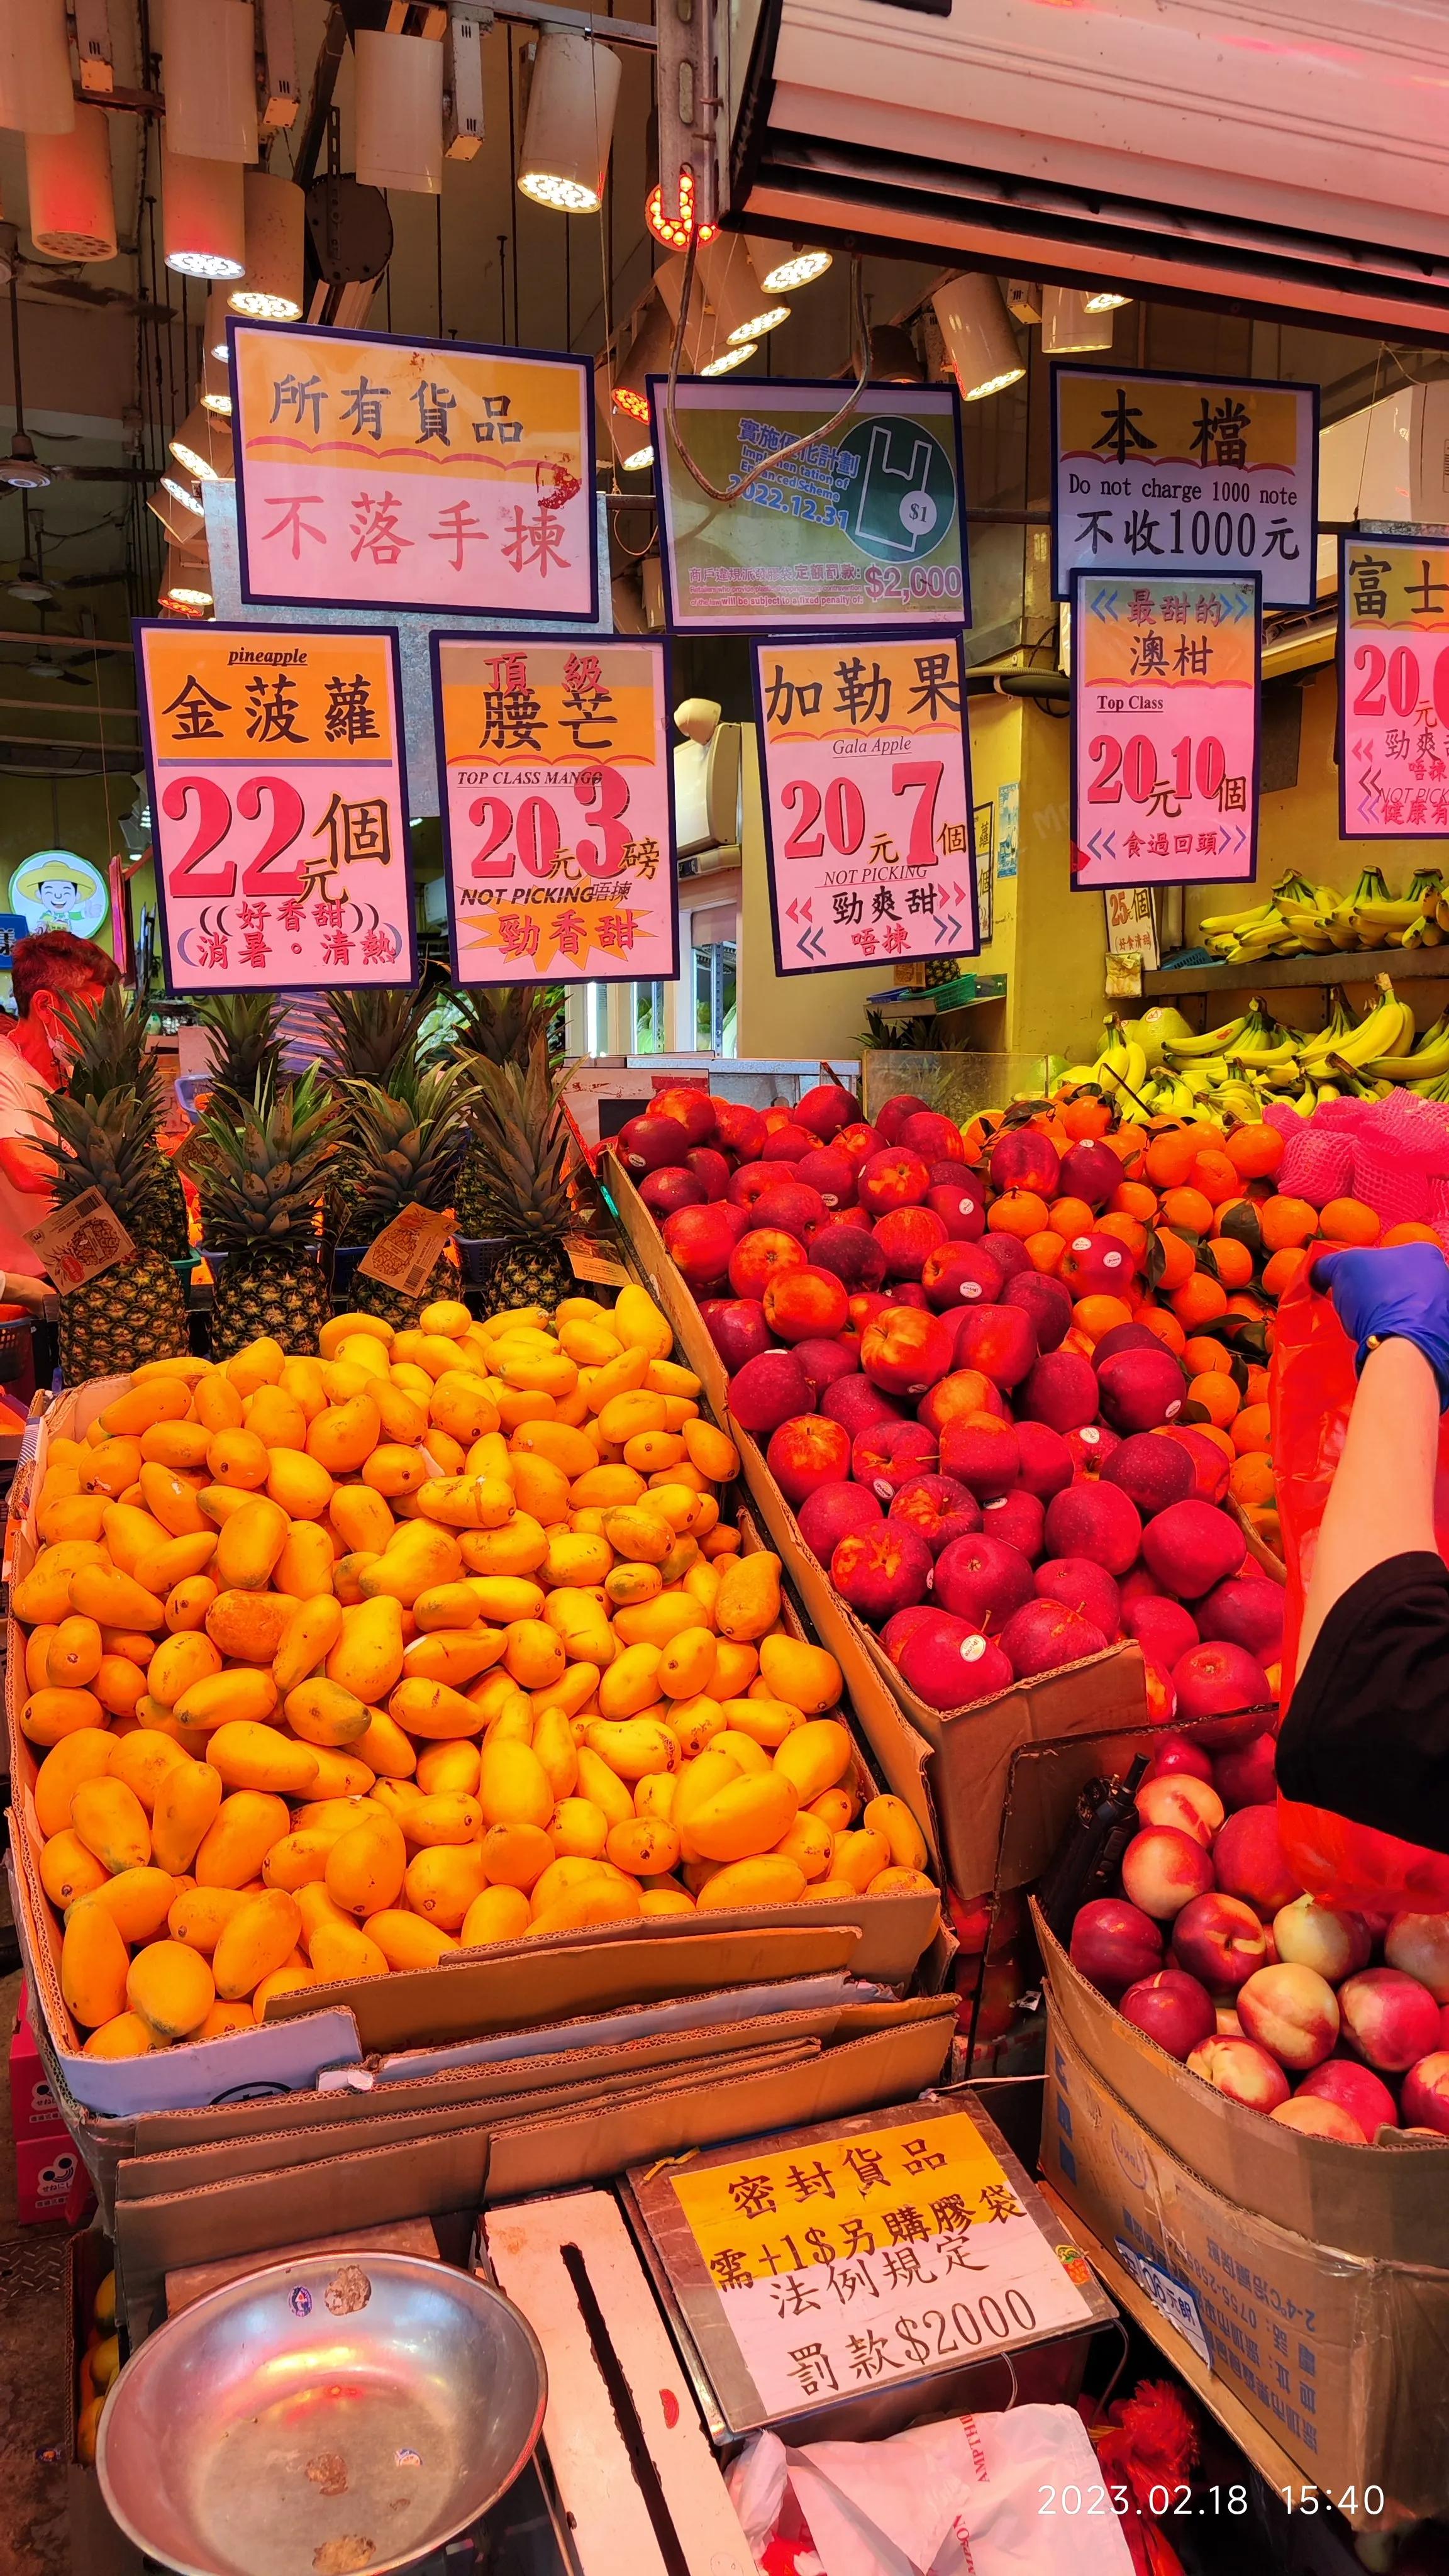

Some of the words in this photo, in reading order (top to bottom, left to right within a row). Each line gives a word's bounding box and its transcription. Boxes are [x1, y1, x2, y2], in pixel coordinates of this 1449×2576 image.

[269, 373, 523, 445] 所有貨品
[1092, 389, 1250, 470] 本檔
[726, 474, 849, 530] 2022.12.31
[798, 480, 840, 502] Scheme
[835, 478, 849, 490] of
[1070, 473, 1091, 494] Do
[1101, 478, 1131, 496] not
[1141, 477, 1202, 501] charge
[1213, 481, 1250, 503] 1000
[1260, 487, 1297, 505] note
[909, 502, 928, 524] $1
[262, 491, 571, 578] 不落手揀
[1075, 509, 1299, 560] 不收1000元
[721, 596, 736, 605] will
[738, 597, 748, 605] be
[750, 596, 780, 607] subject
[782, 596, 790, 604] to
[799, 595, 819, 604] fixed
[821, 595, 850, 606] penalty
[865, 566, 962, 603] $2,000
[1127, 588, 1221, 626] 最甜的
[228, 647, 307, 666] pineapple
[1130, 630, 1213, 676] 澳柑
[484, 652, 608, 696] 頂級
[765, 653, 962, 726] 加勒果
[162, 674, 380, 745] 金菠蘿
[479, 687, 617, 751] 腰芒
[1097, 696, 1124, 710] Top
[1129, 695, 1163, 709] Class
[833, 739, 868, 755] Gala
[872, 737, 911, 756] Apple
[1385, 726, 1449, 762] 勁爽
[457, 772, 489, 786] TOP
[492, 771, 541, 786] CLASS
[545, 772, 603, 786] MANGO
[1381, 787, 1414, 804] NOT
[1122, 830, 1218, 859] 食過回頭
[824, 870, 859, 886] NOT
[863, 865, 929, 884] PICKING
[460, 888, 508, 906] NOT
[511, 887, 594, 905] PICKING
[833, 883, 938, 924] 勁爽甜
[498, 909, 637, 955] 勁香甜
[851, 923, 911, 956] 唔揀
[728, 2138, 948, 2219] 密封貨品
[769, 2235, 991, 2320] 法例規定
[786, 2289, 1038, 2397] 罰款$2000
